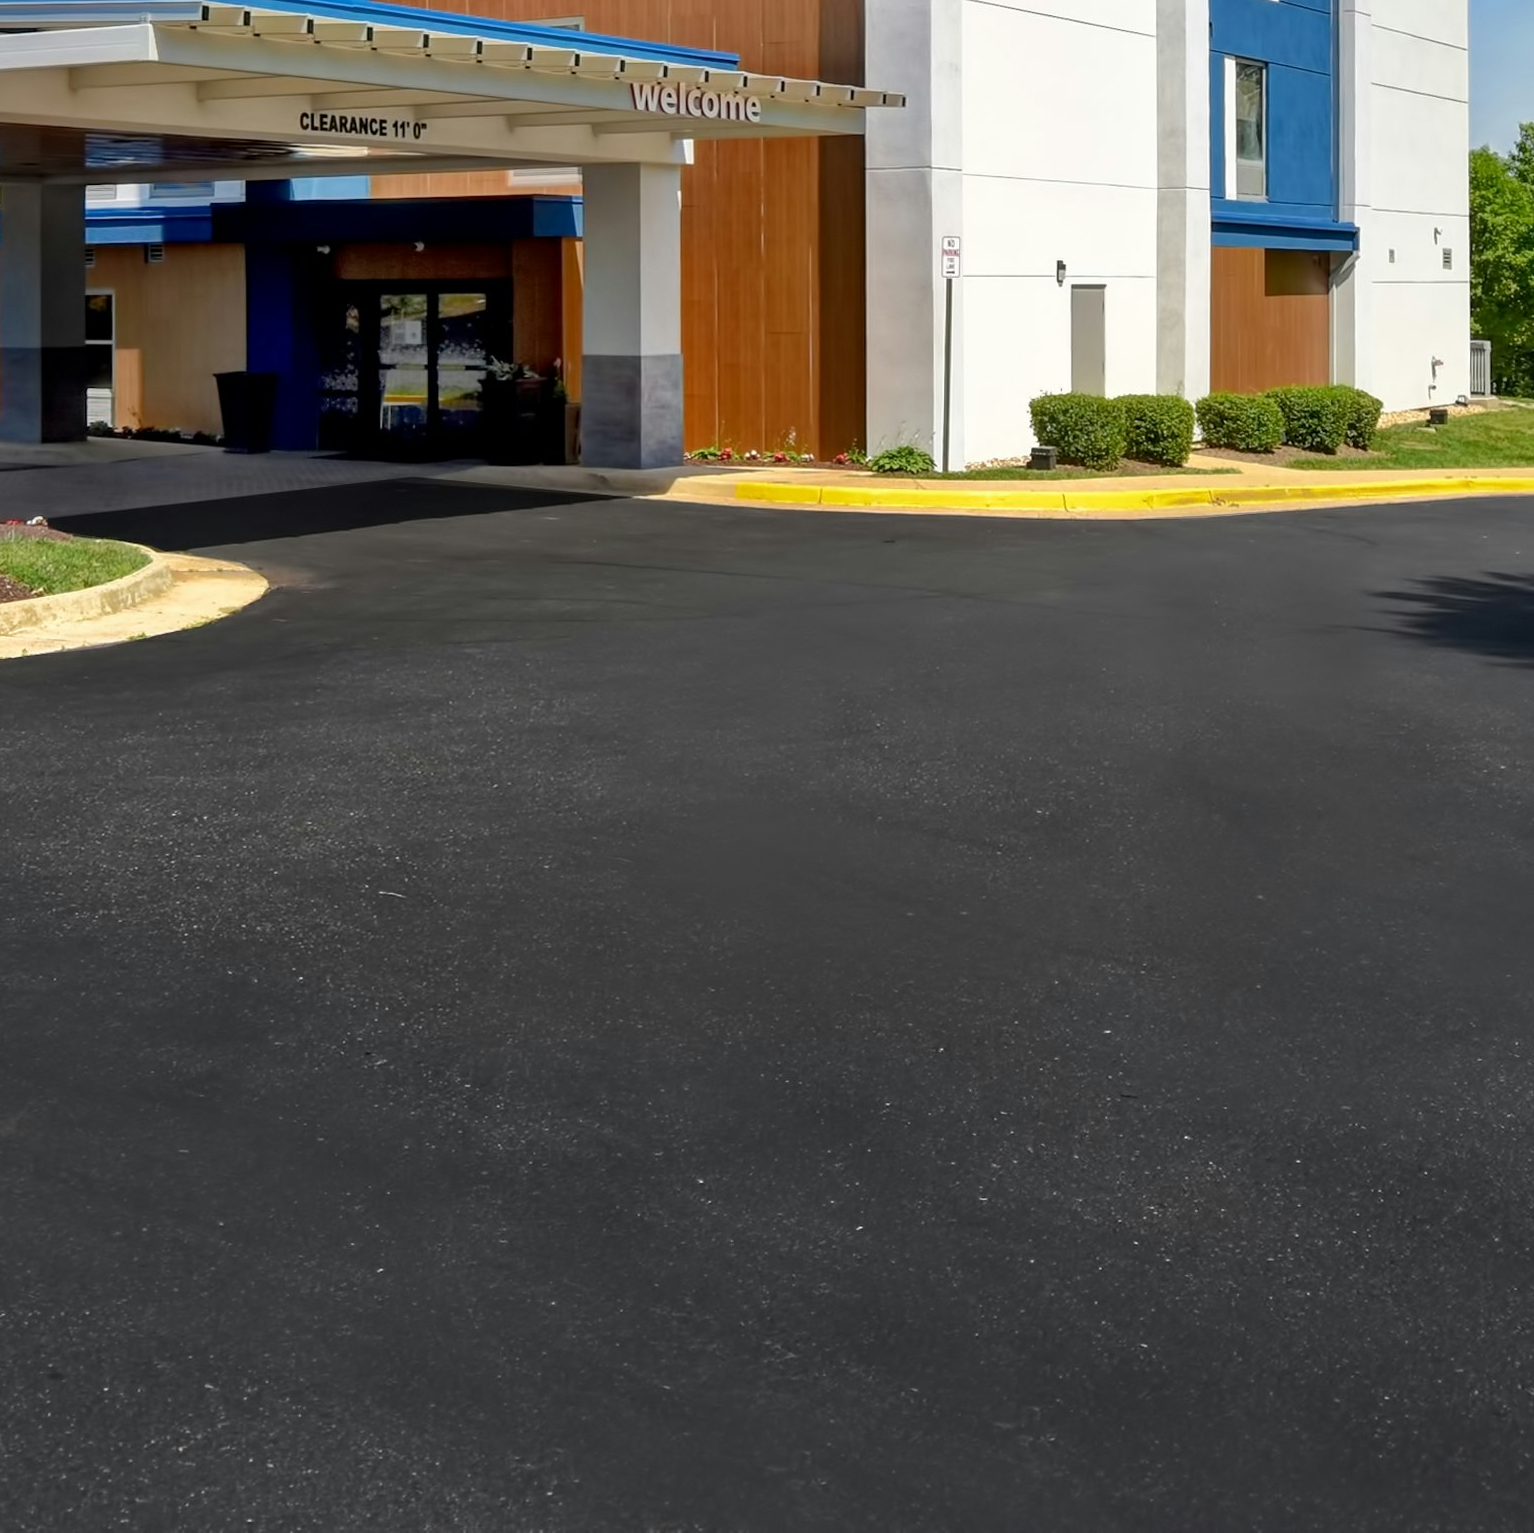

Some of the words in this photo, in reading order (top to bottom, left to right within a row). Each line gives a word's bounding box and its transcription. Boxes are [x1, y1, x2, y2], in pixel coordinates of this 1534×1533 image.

[630, 82, 761, 123] welcome
[300, 112, 387, 136] CLEARANCE
[392, 120, 410, 138] 11'
